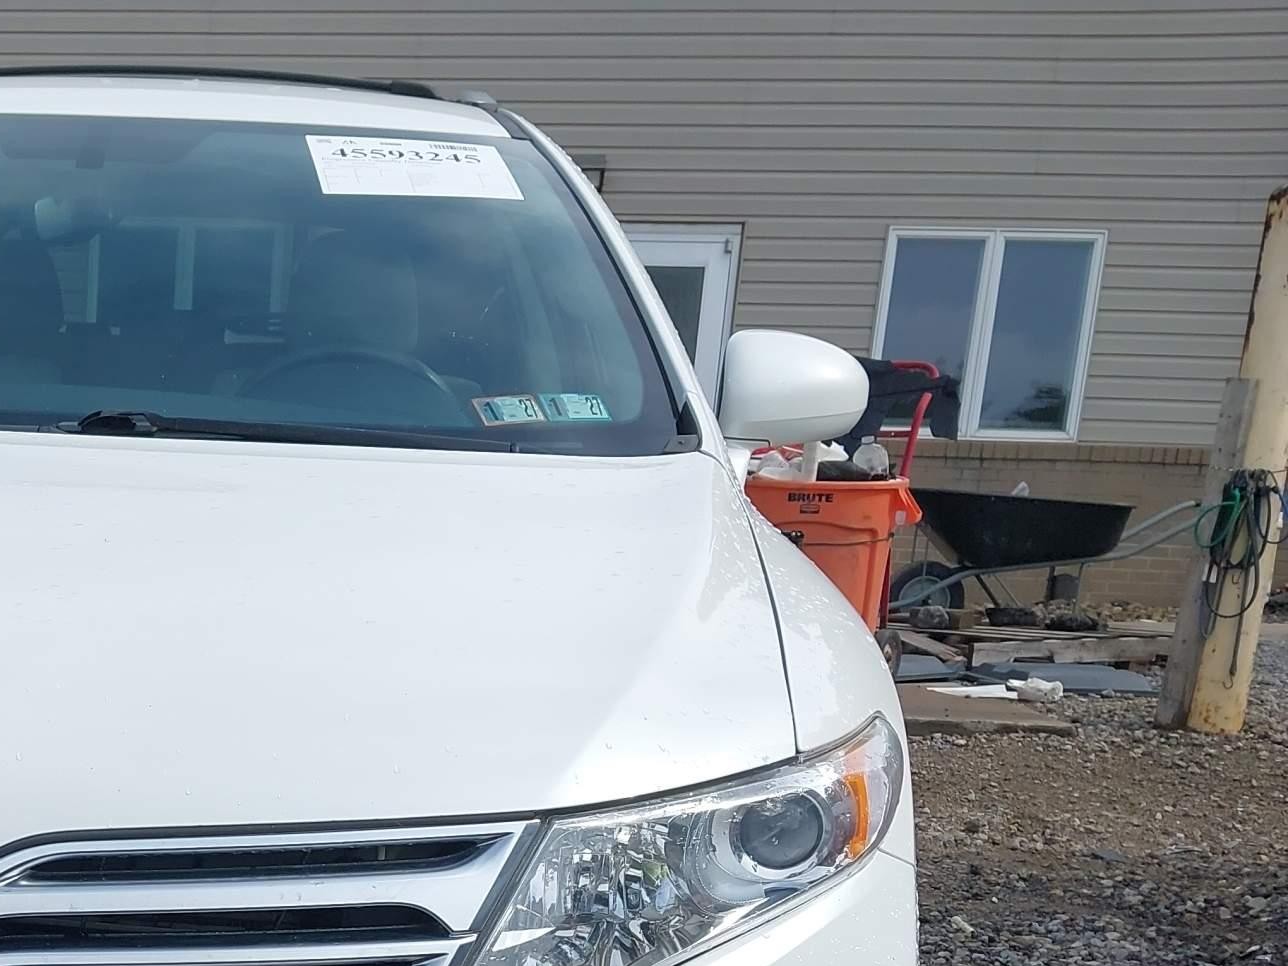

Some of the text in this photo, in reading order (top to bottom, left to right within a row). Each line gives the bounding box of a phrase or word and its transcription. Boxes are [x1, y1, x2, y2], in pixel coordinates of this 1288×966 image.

[332, 148, 481, 164] 45593245
[518, 398, 538, 418] 27
[585, 396, 603, 416] 27
[787, 492, 834, 503] BRUTE
